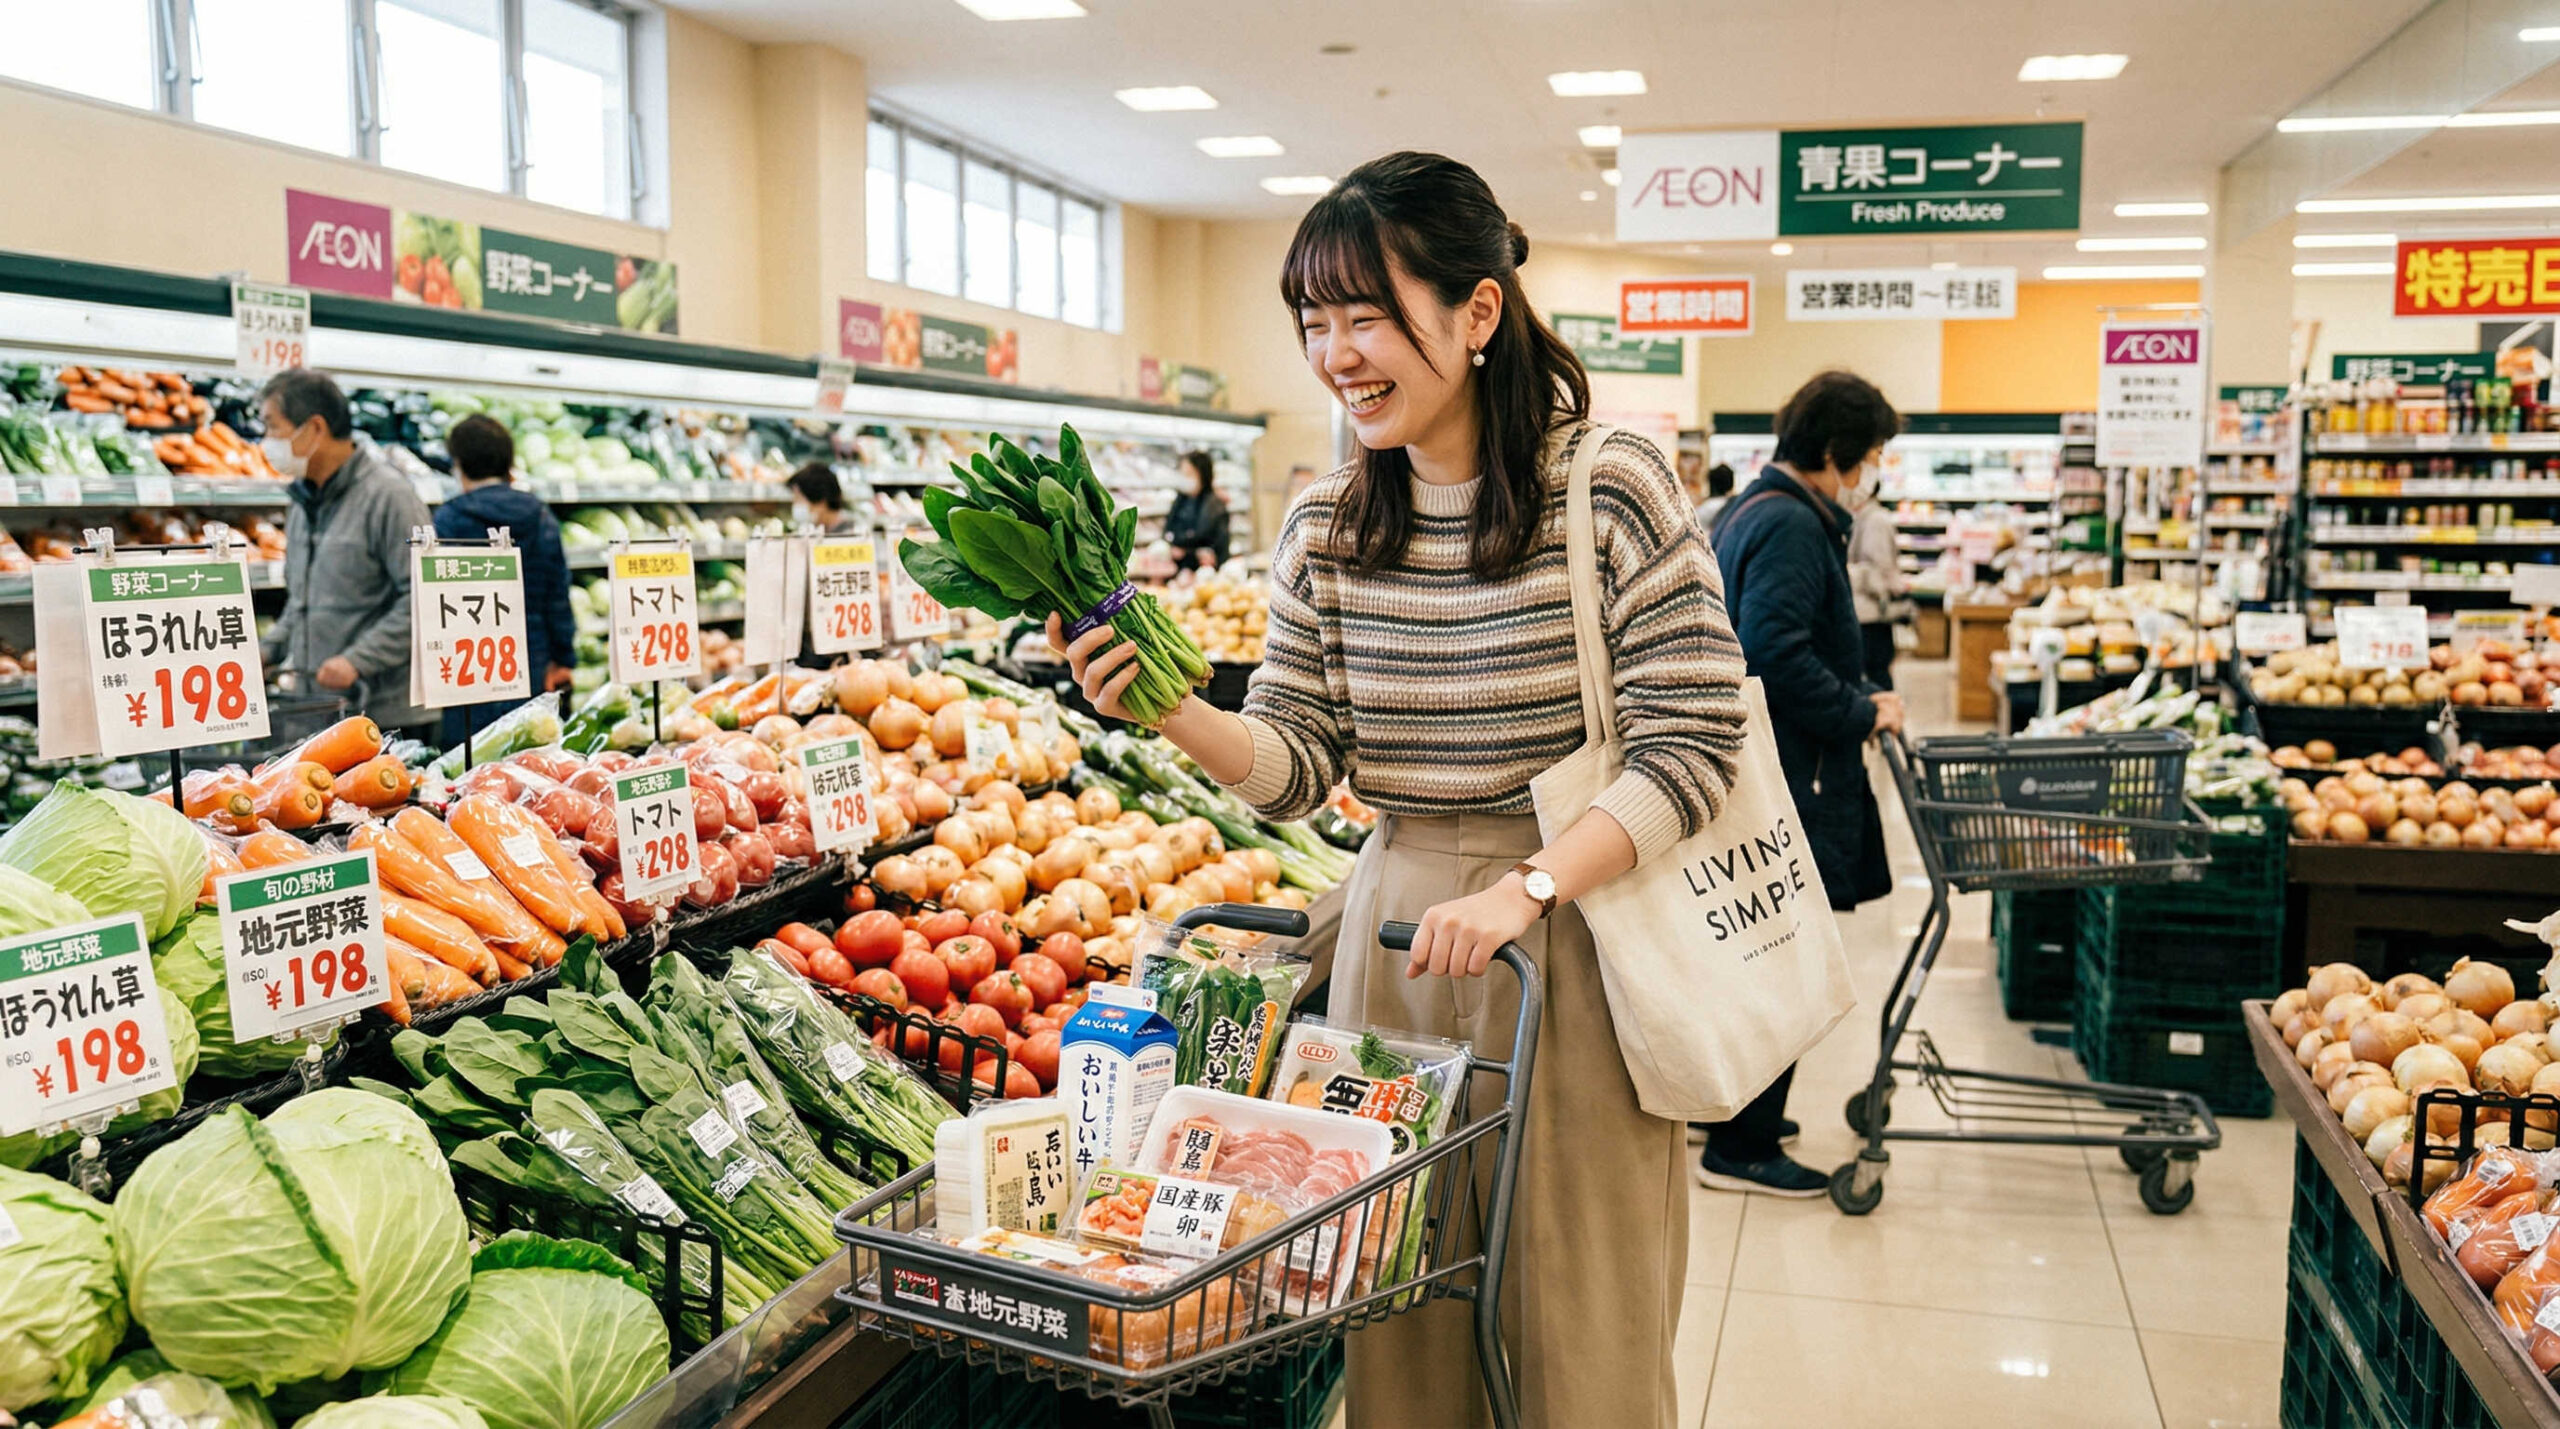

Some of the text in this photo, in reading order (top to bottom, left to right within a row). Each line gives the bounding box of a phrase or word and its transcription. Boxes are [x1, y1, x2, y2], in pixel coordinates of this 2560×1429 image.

[1798, 142, 2063, 191] 青果コーナー
[1852, 200, 2005, 223] Fresh Produce
[485, 249, 614, 302] 野菜コーナー
[1627, 289, 1744, 322] 営業時間
[2345, 358, 2485, 382] 野菜コーナー
[111, 569, 224, 596] 野菜コーナー
[629, 584, 685, 617] トマト
[101, 606, 248, 660] ほうれん草
[439, 591, 511, 629] トマト
[827, 602, 873, 639] ¥298
[439, 635, 518, 688] ¥298
[630, 621, 690, 667] ¥298
[125, 661, 248, 729] ¥198
[631, 799, 682, 836] トマト
[635, 832, 690, 880] ¥298
[1683, 818, 1791, 897] LIVING
[239, 895, 370, 957] 地元野菜
[20, 933, 103, 972] 地元野菜
[264, 943, 369, 1011] ¥198
[0, 964, 145, 1040] ほうれん草
[32, 1019, 146, 1099] ¥198
[1076, 1052, 1103, 1173] おいしい牛
[1156, 1184, 1226, 1215] 国産豚
[1176, 1213, 1200, 1240] 卵
